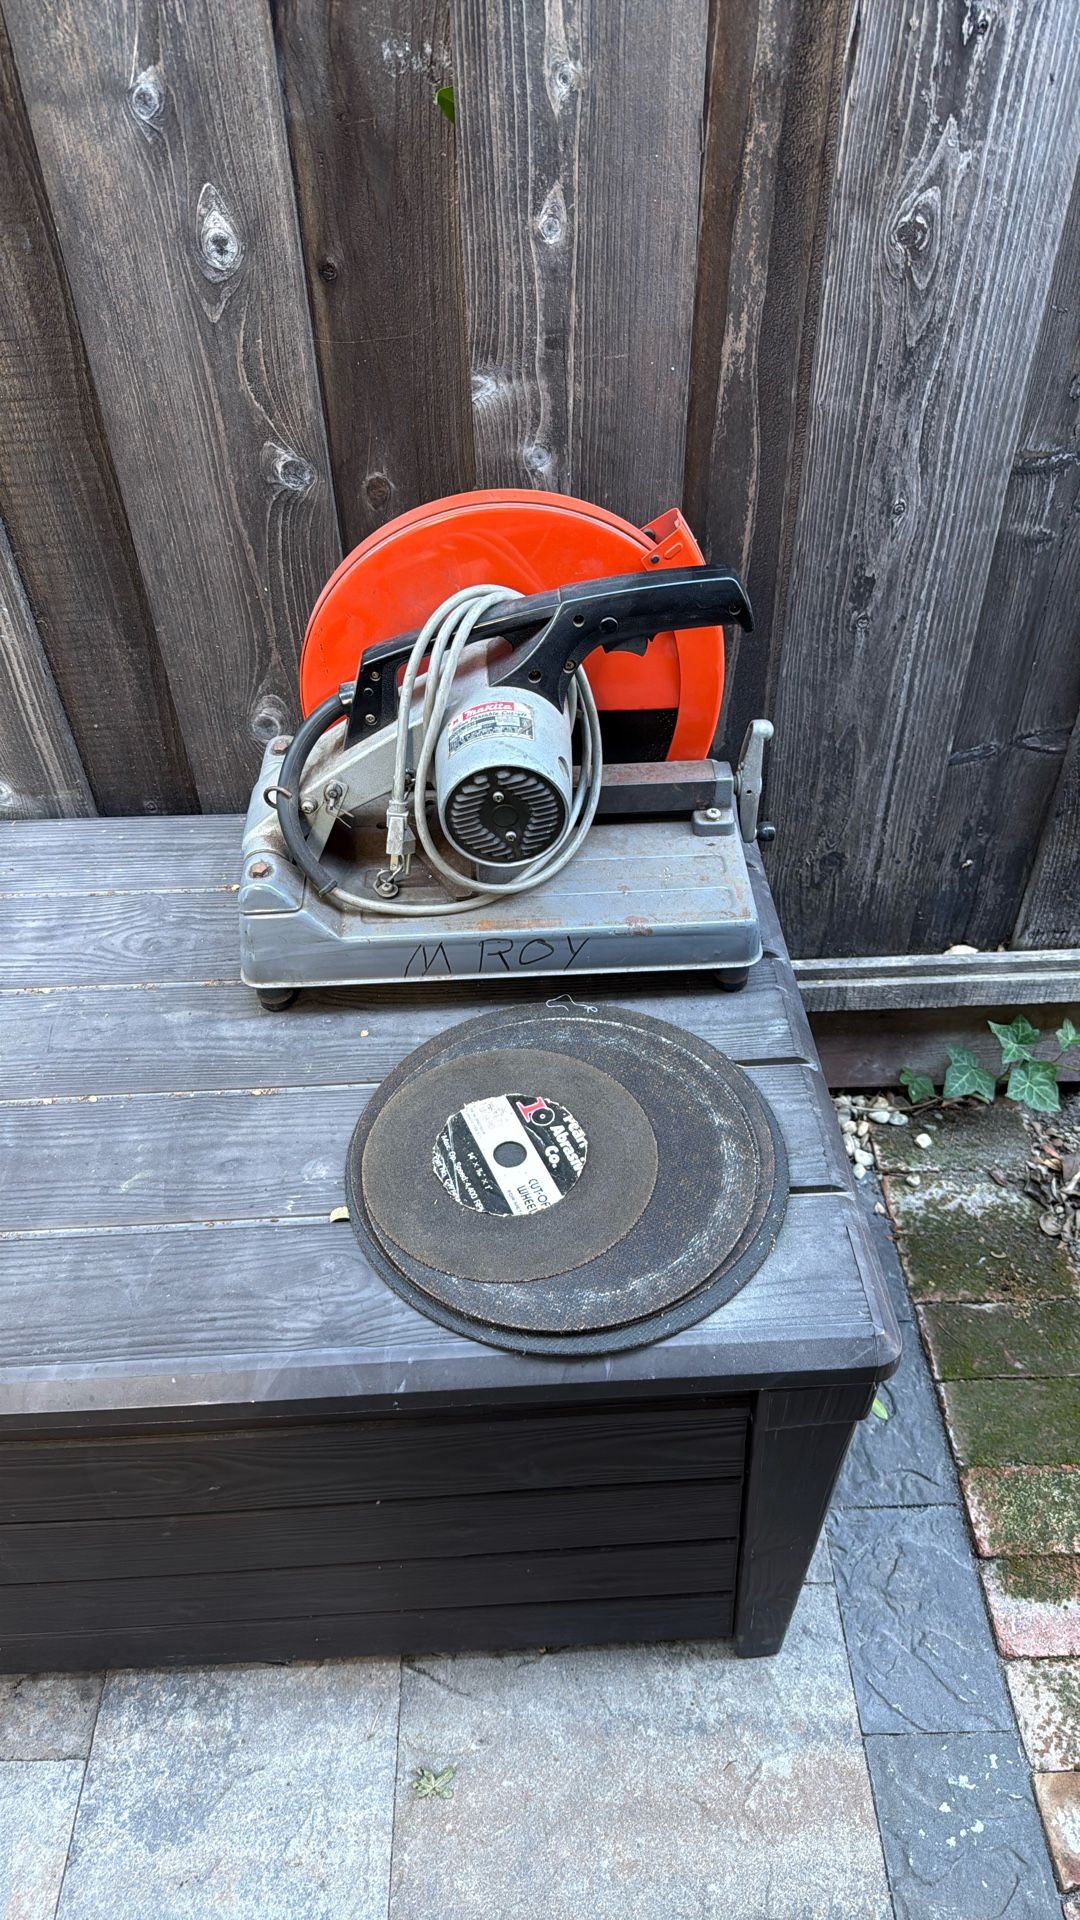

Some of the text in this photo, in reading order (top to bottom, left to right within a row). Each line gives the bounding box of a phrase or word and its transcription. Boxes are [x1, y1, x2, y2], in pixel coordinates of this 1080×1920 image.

[465, 702, 512, 720] Makita
[404, 935, 590, 977] M ROY
[544, 1145, 560, 1168] Co.
